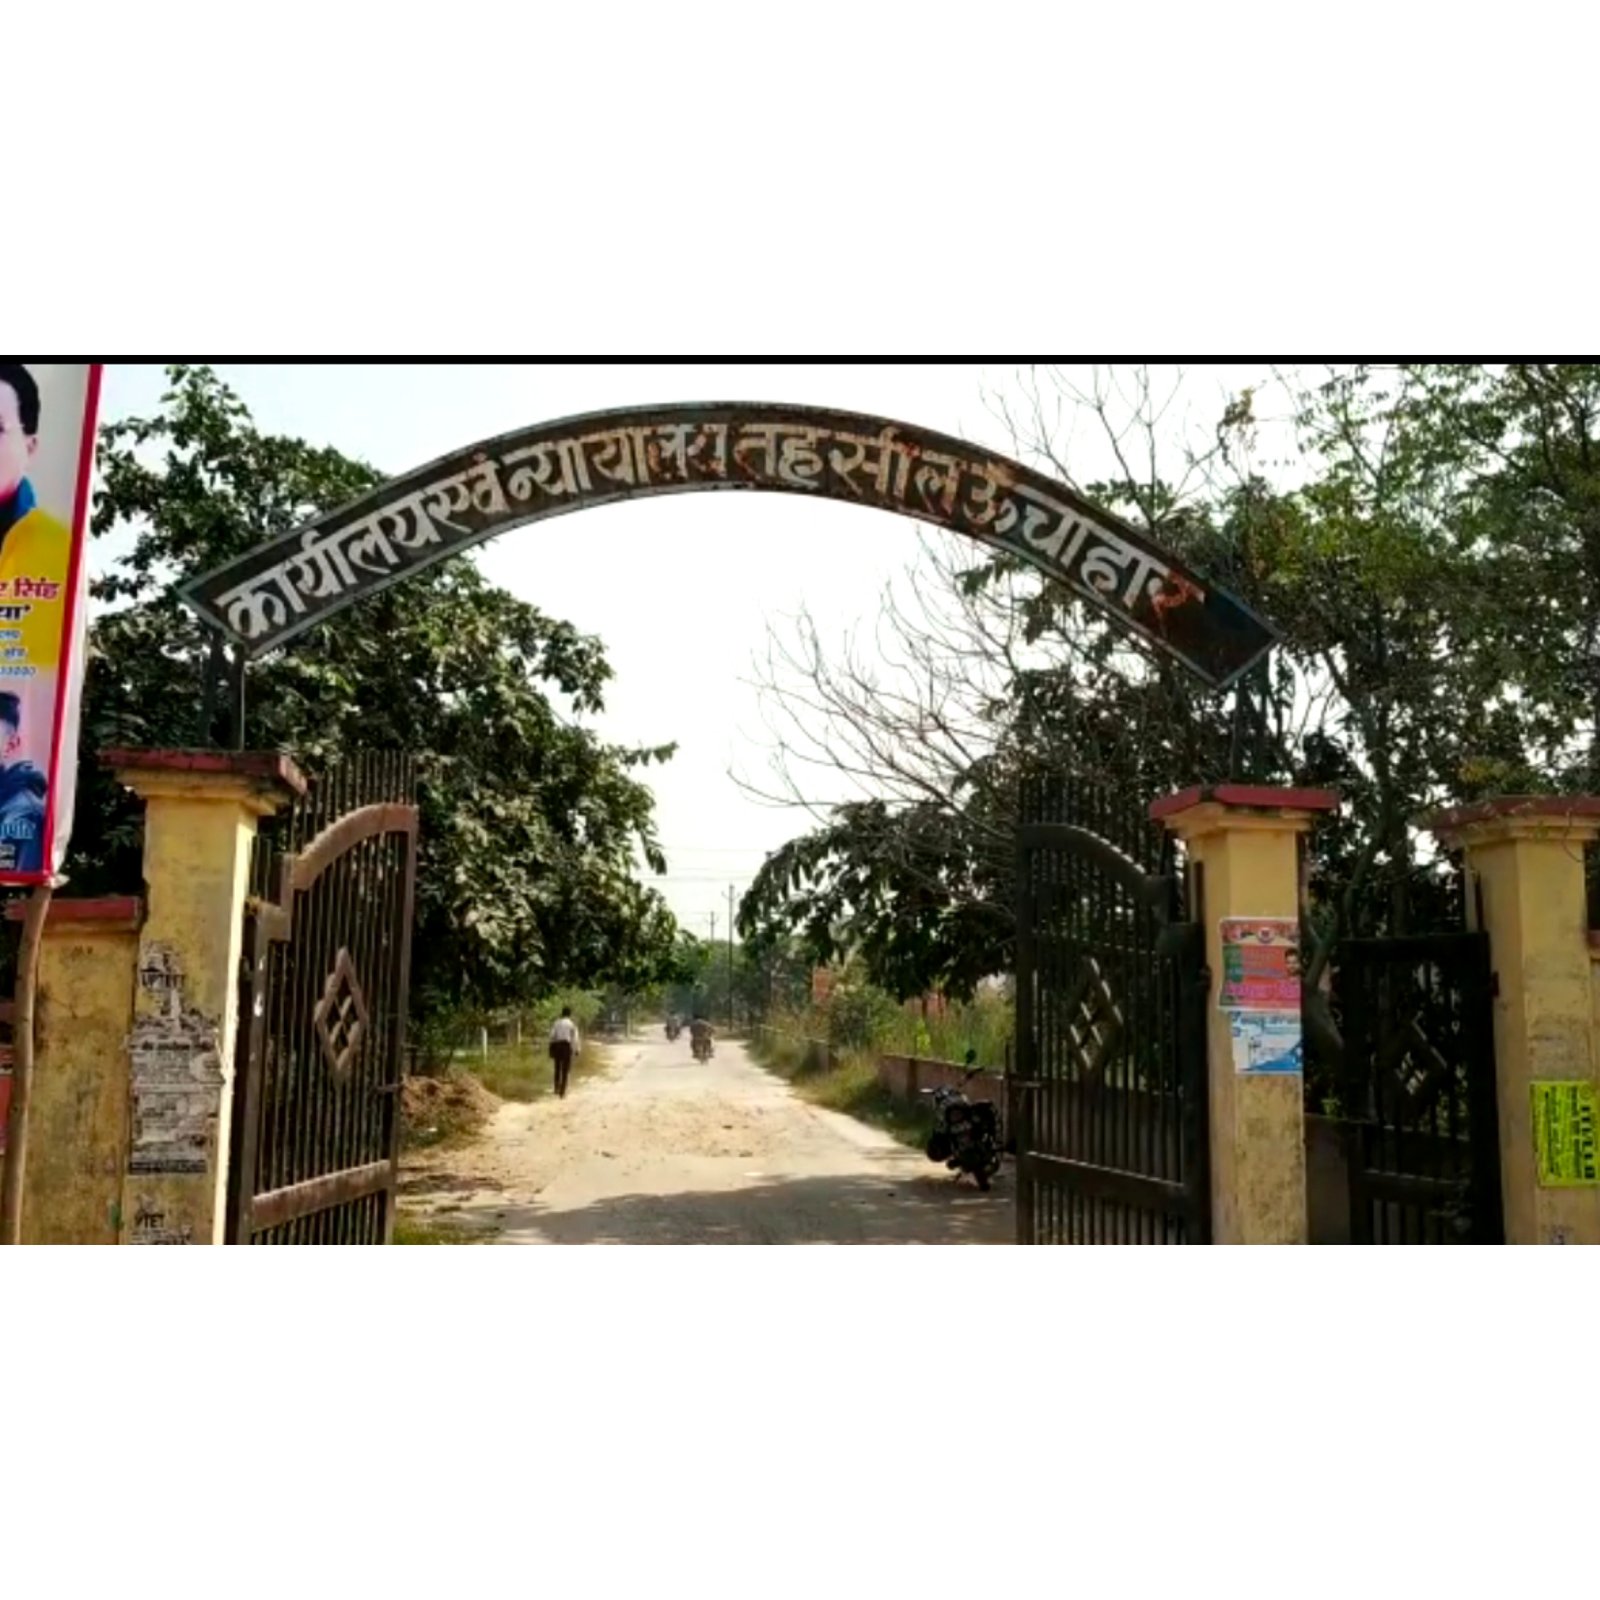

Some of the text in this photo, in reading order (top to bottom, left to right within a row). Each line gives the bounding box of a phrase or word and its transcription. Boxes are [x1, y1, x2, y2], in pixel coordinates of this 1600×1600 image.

[216, 489, 442, 639] कार्यालय
[502, 424, 728, 501] न्यायालय
[734, 422, 967, 516] तहसील
